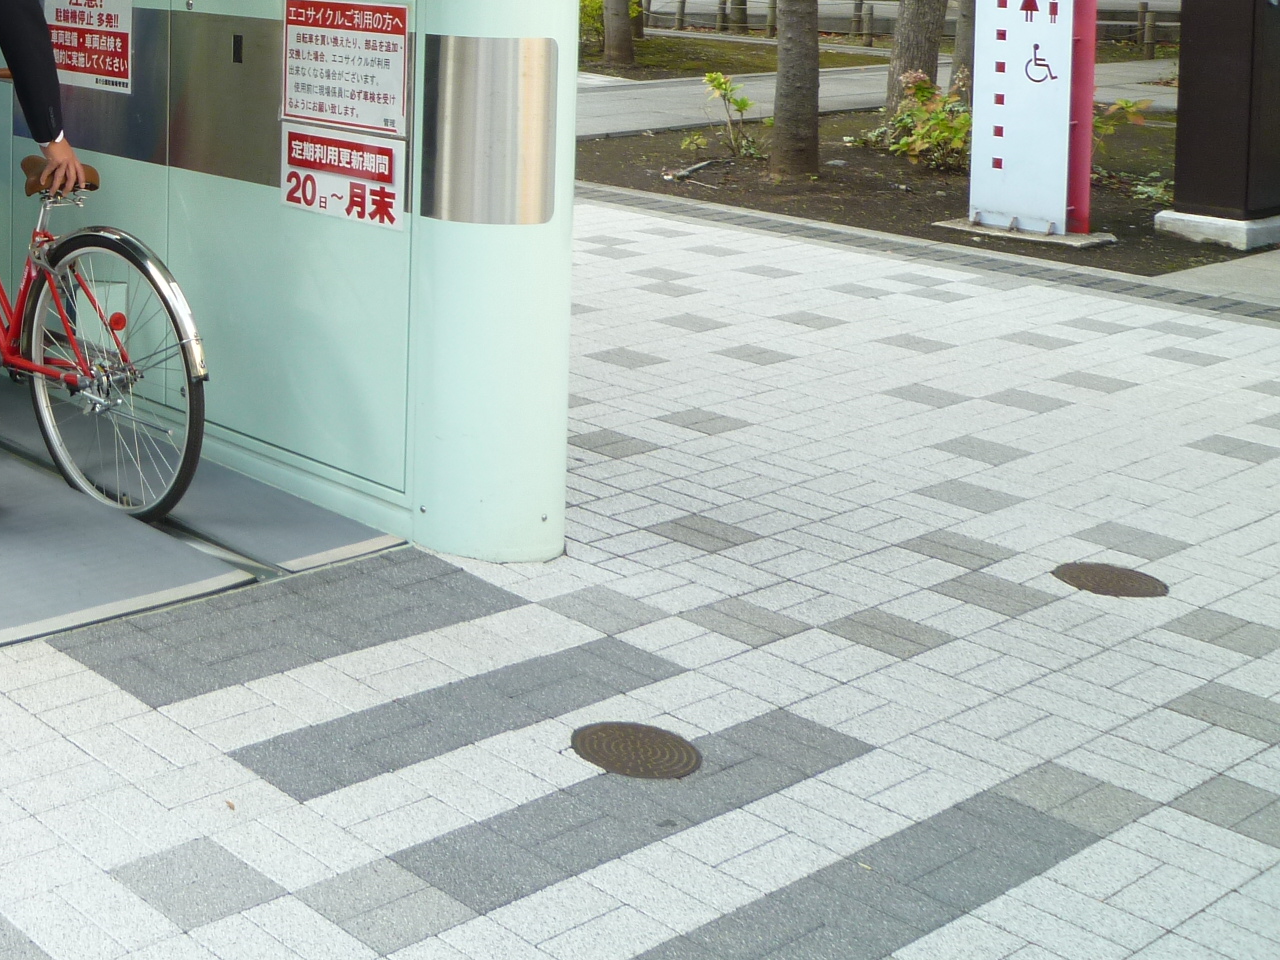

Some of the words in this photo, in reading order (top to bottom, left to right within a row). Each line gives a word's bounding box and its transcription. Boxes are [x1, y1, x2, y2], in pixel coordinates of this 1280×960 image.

[55, 8, 94, 26] 駐輪機停止
[97, 13, 119, 28] 多発!!
[288, 7, 403, 31] エコサイクルご利用の方へ
[288, 49, 391, 70] 交換した場合、エコサイクルが利用
[288, 65, 380, 87] 出来なくなる場合がございます。
[288, 97, 360, 118] るようにお願い致します。
[291, 139, 389, 175] 定期利用更新期間
